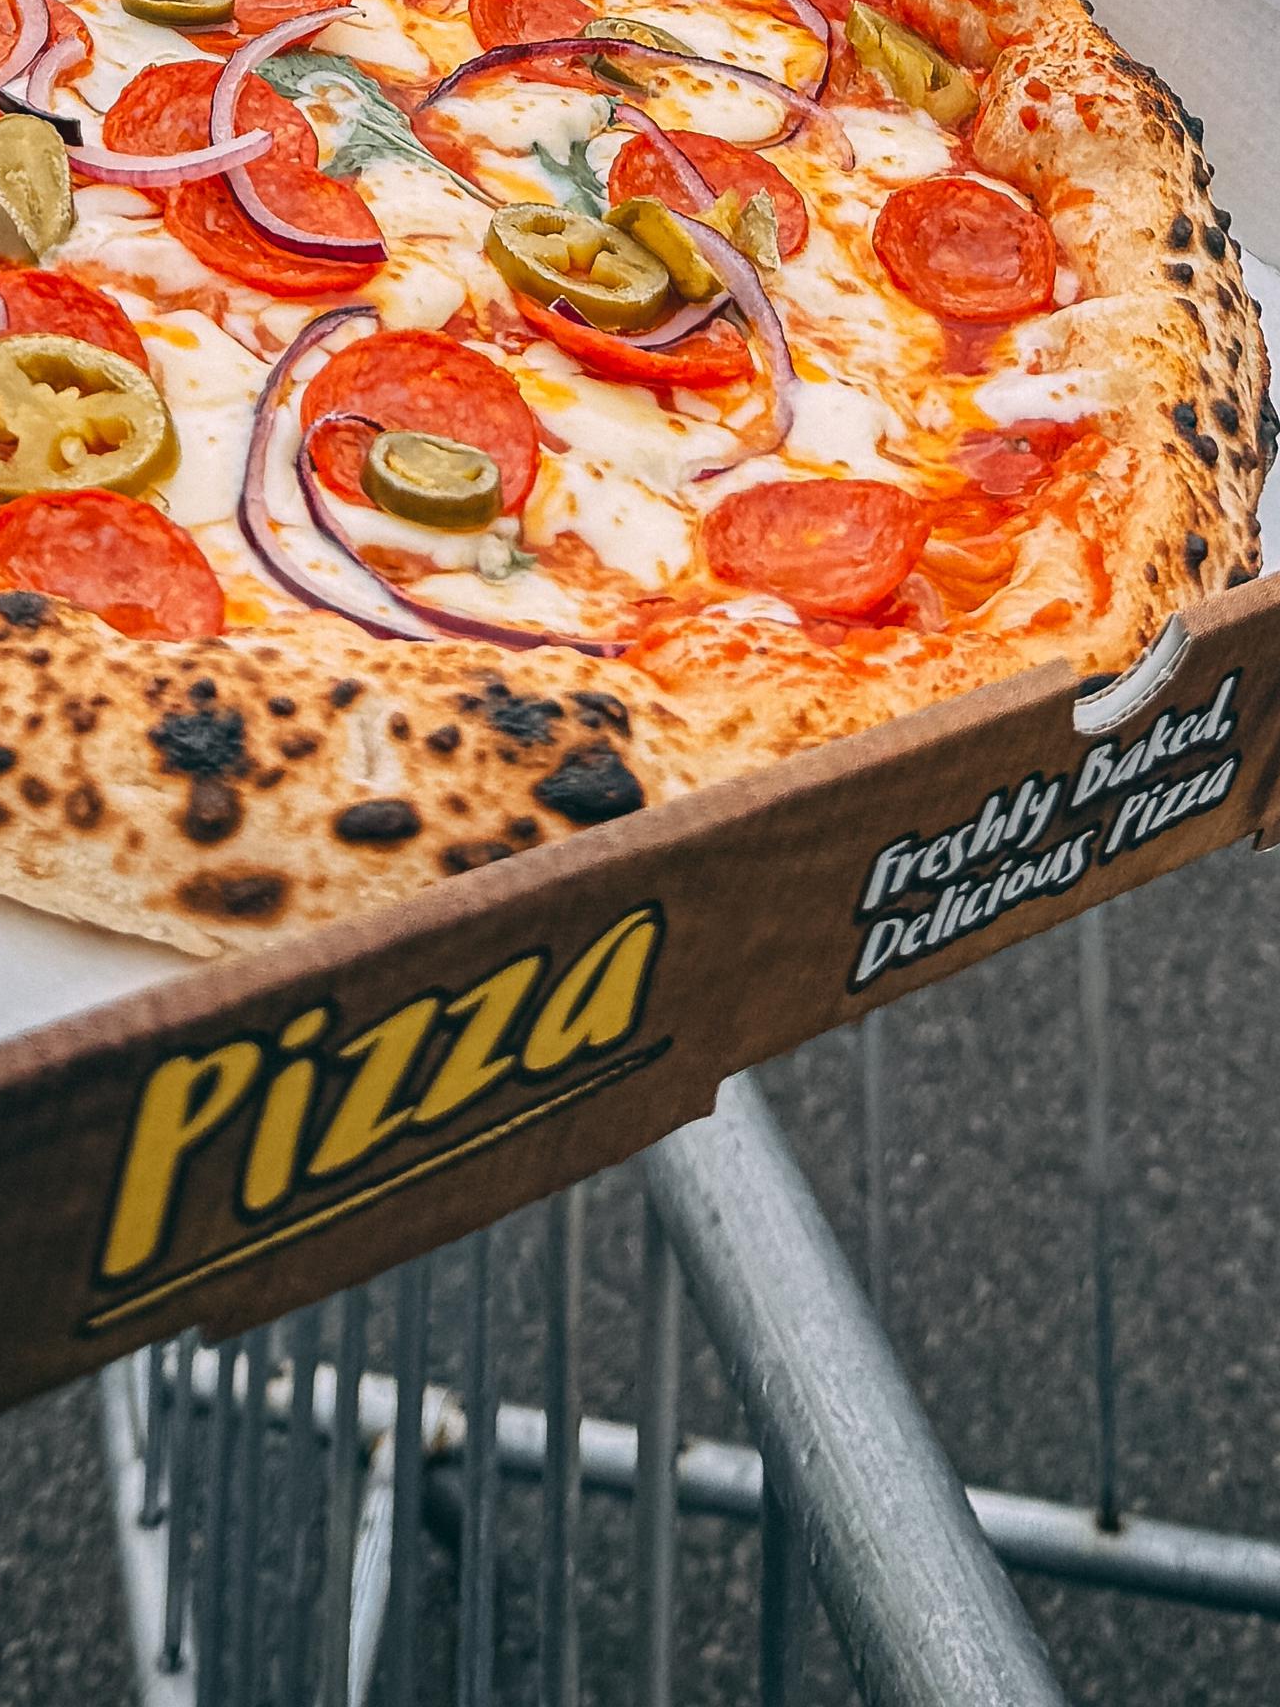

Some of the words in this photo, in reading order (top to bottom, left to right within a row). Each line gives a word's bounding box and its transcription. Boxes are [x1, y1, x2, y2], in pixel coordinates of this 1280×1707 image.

[854, 829, 1094, 984] Delicious
[1105, 758, 1236, 855] Pizza
[861, 778, 1060, 911] Freshly
[1070, 675, 1236, 809] Baked,
[101, 905, 664, 1280] Pizza
